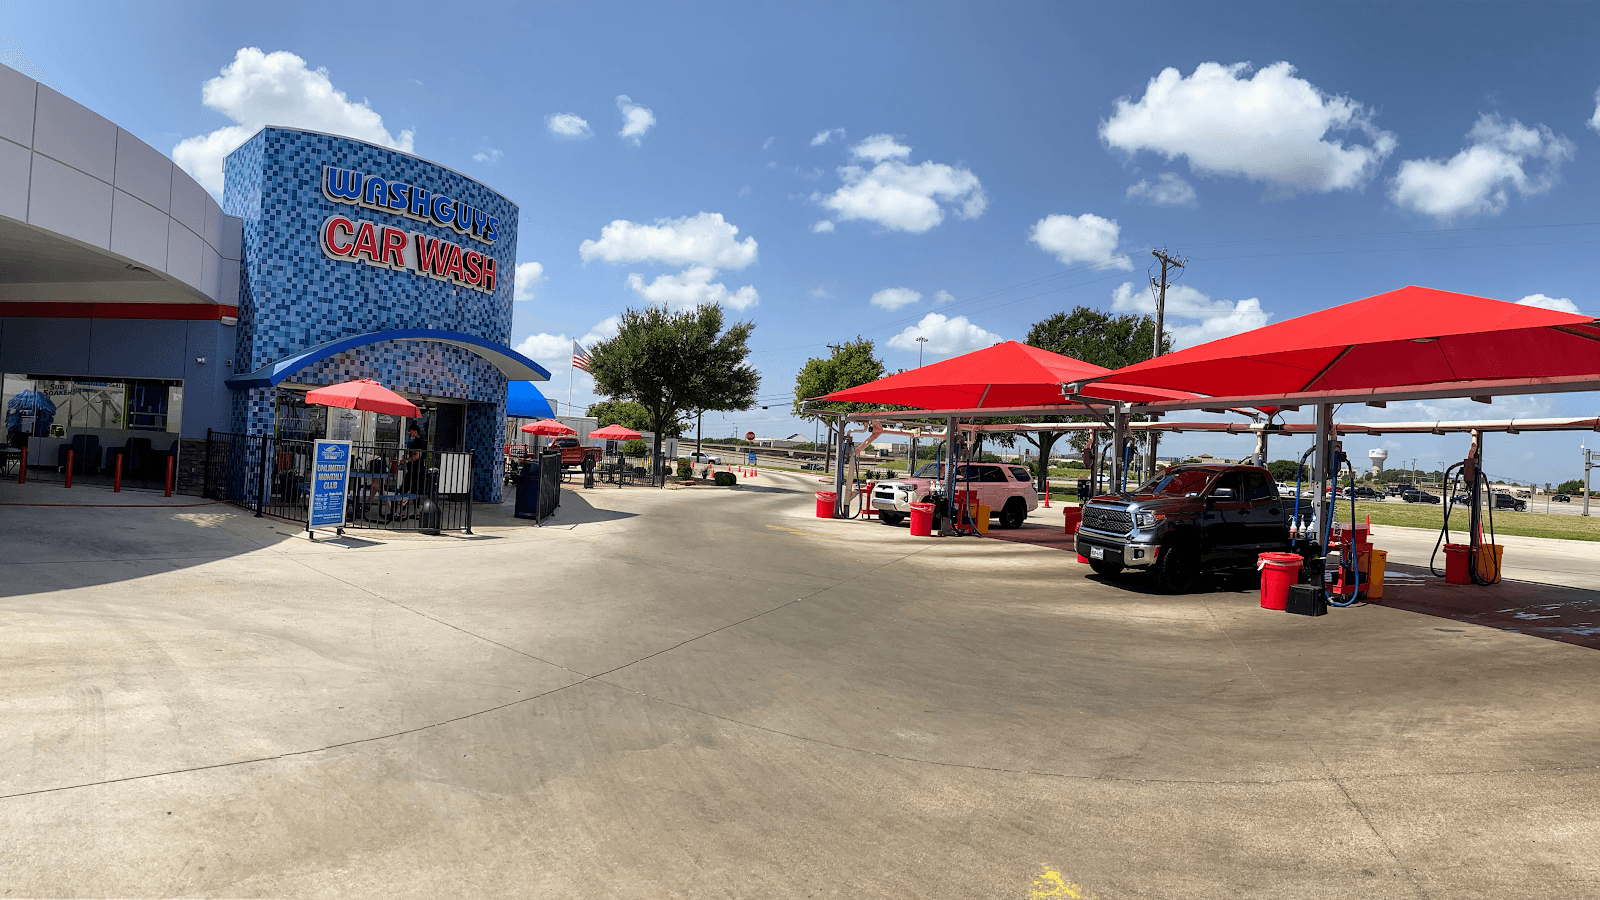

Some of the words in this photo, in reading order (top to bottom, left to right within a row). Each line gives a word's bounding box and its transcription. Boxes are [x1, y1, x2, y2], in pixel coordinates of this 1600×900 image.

[326, 166, 500, 242] WASHGUYS
[325, 217, 407, 267] CAR
[417, 234, 497, 291] WASH
[317, 464, 346, 472] UNLIMITED
[318, 473, 343, 481] MONTHLY
[323, 481, 338, 490] CLUB
